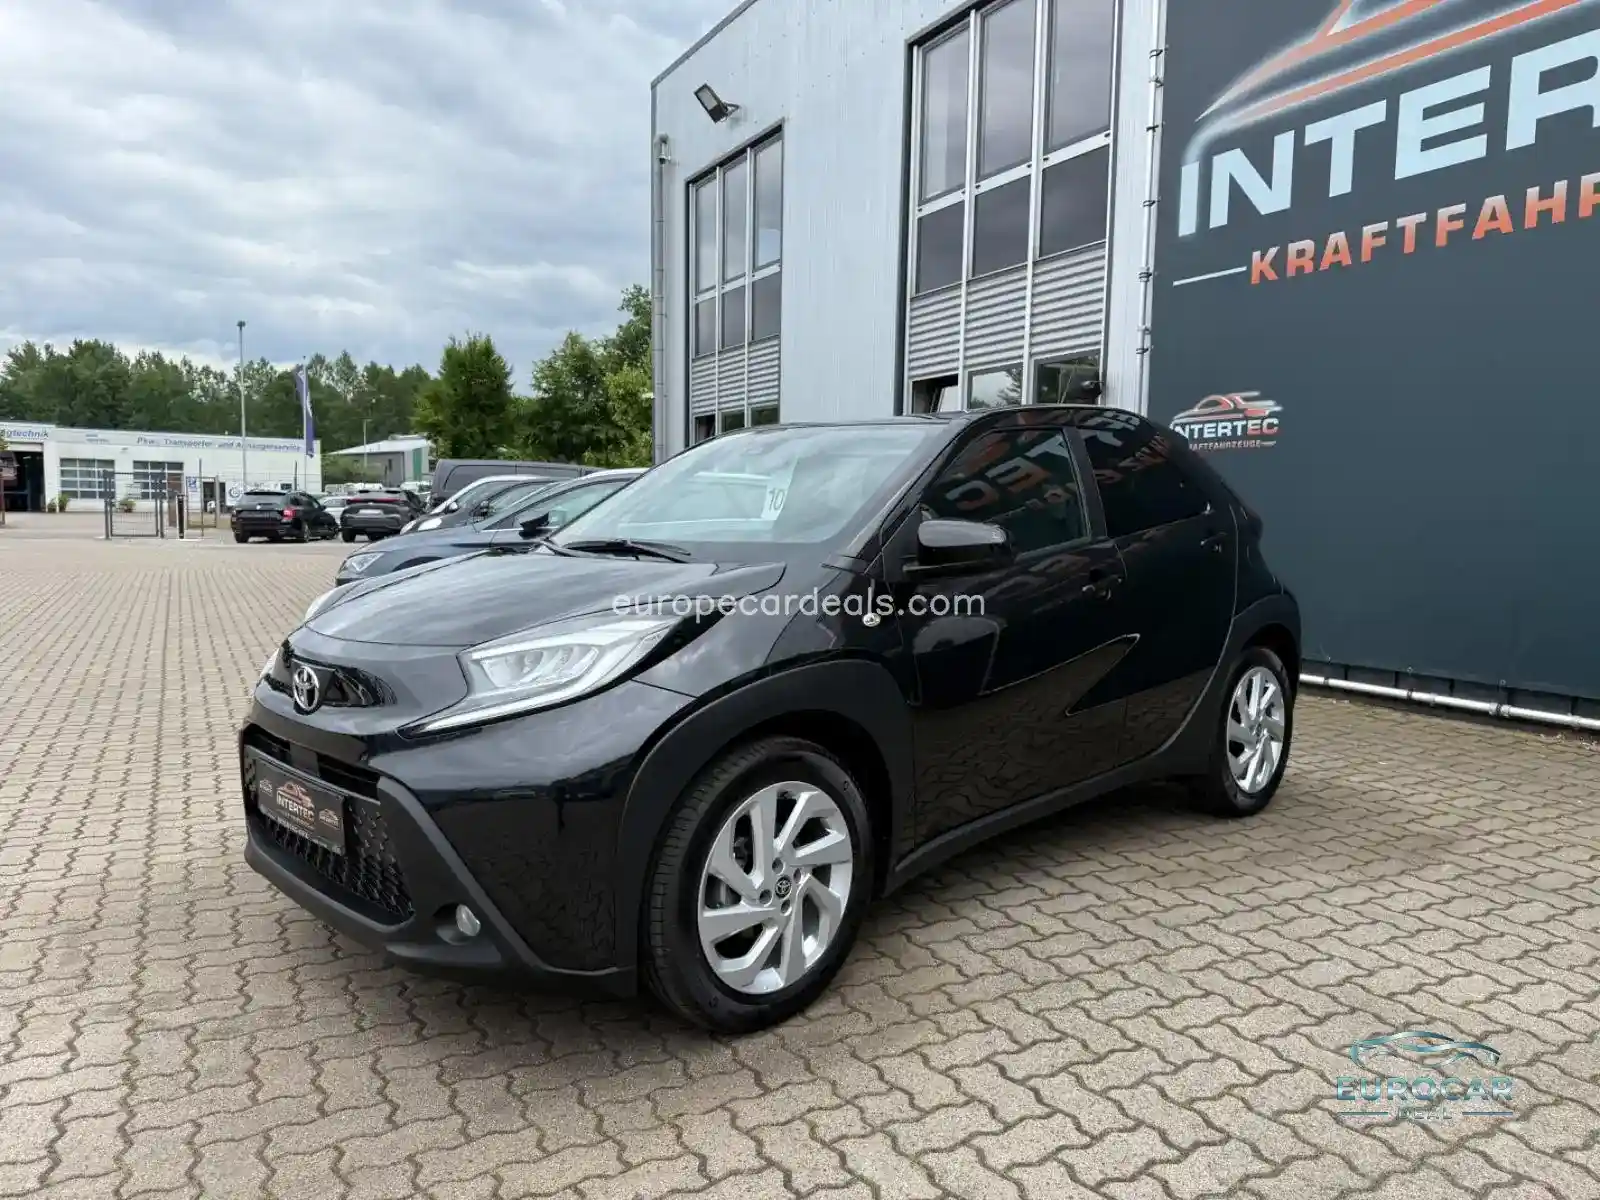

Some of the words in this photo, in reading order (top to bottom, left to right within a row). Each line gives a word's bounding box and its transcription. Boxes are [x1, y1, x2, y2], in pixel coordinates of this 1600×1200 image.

[1178, 29, 1600, 237] INTER
[1174, 418, 1280, 439] NTERTEC
[768, 487, 785, 511] 10
